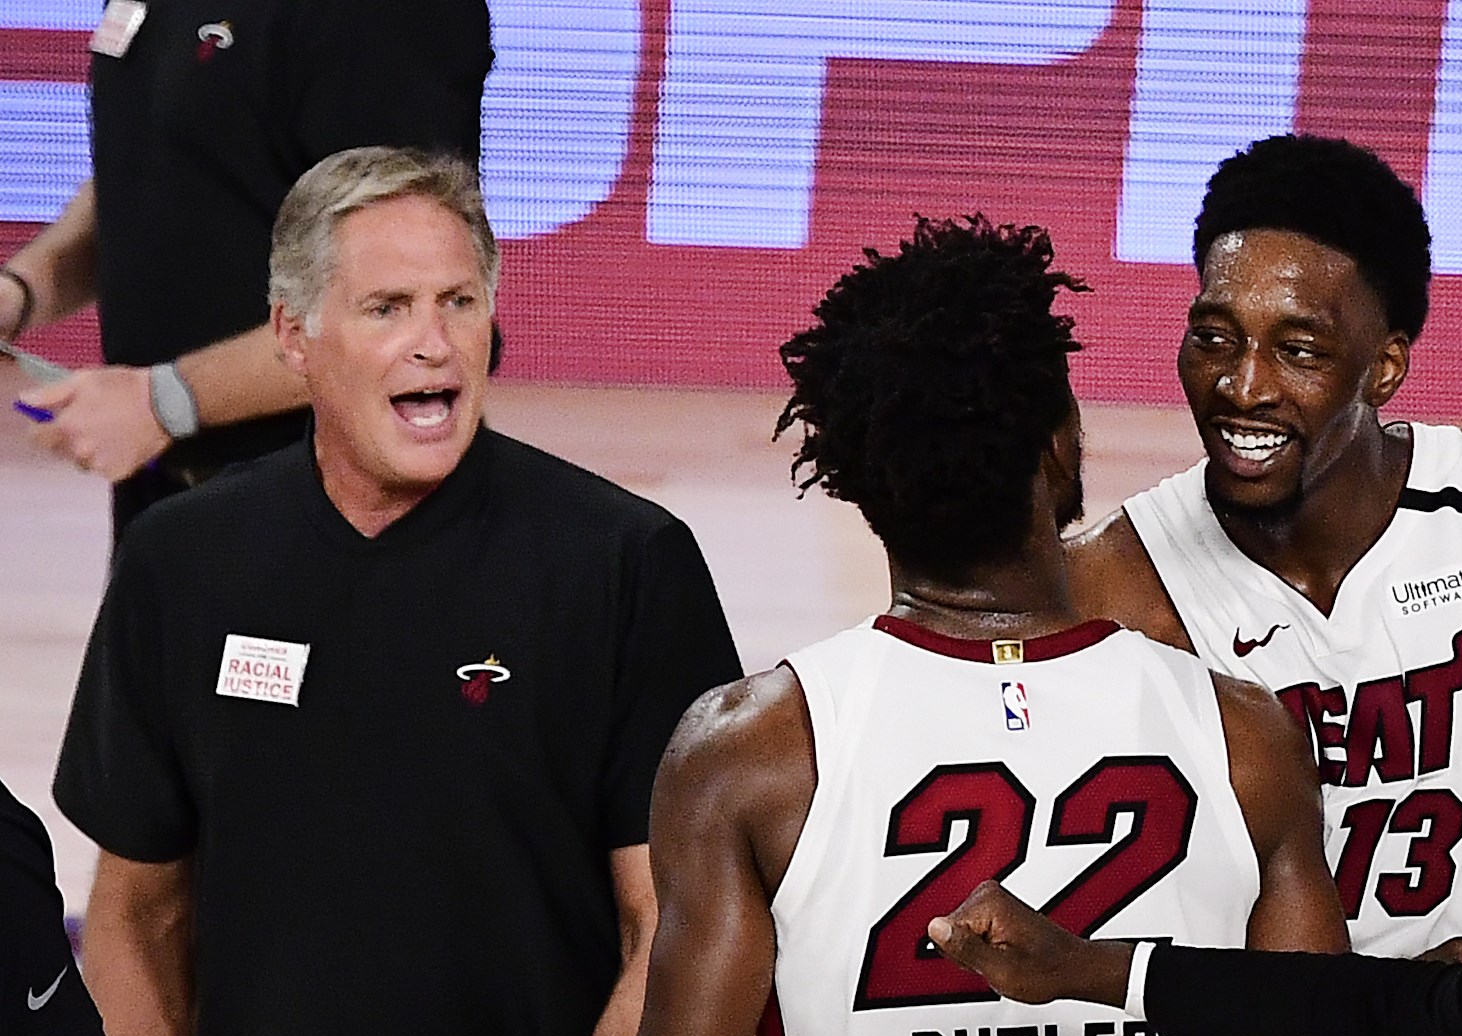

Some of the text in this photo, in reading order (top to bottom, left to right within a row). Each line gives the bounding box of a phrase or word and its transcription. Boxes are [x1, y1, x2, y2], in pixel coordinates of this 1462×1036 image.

[228, 658, 292, 681] RACIAL
[224, 677, 294, 701] JUSTICE
[852, 755, 1199, 1012] 22
